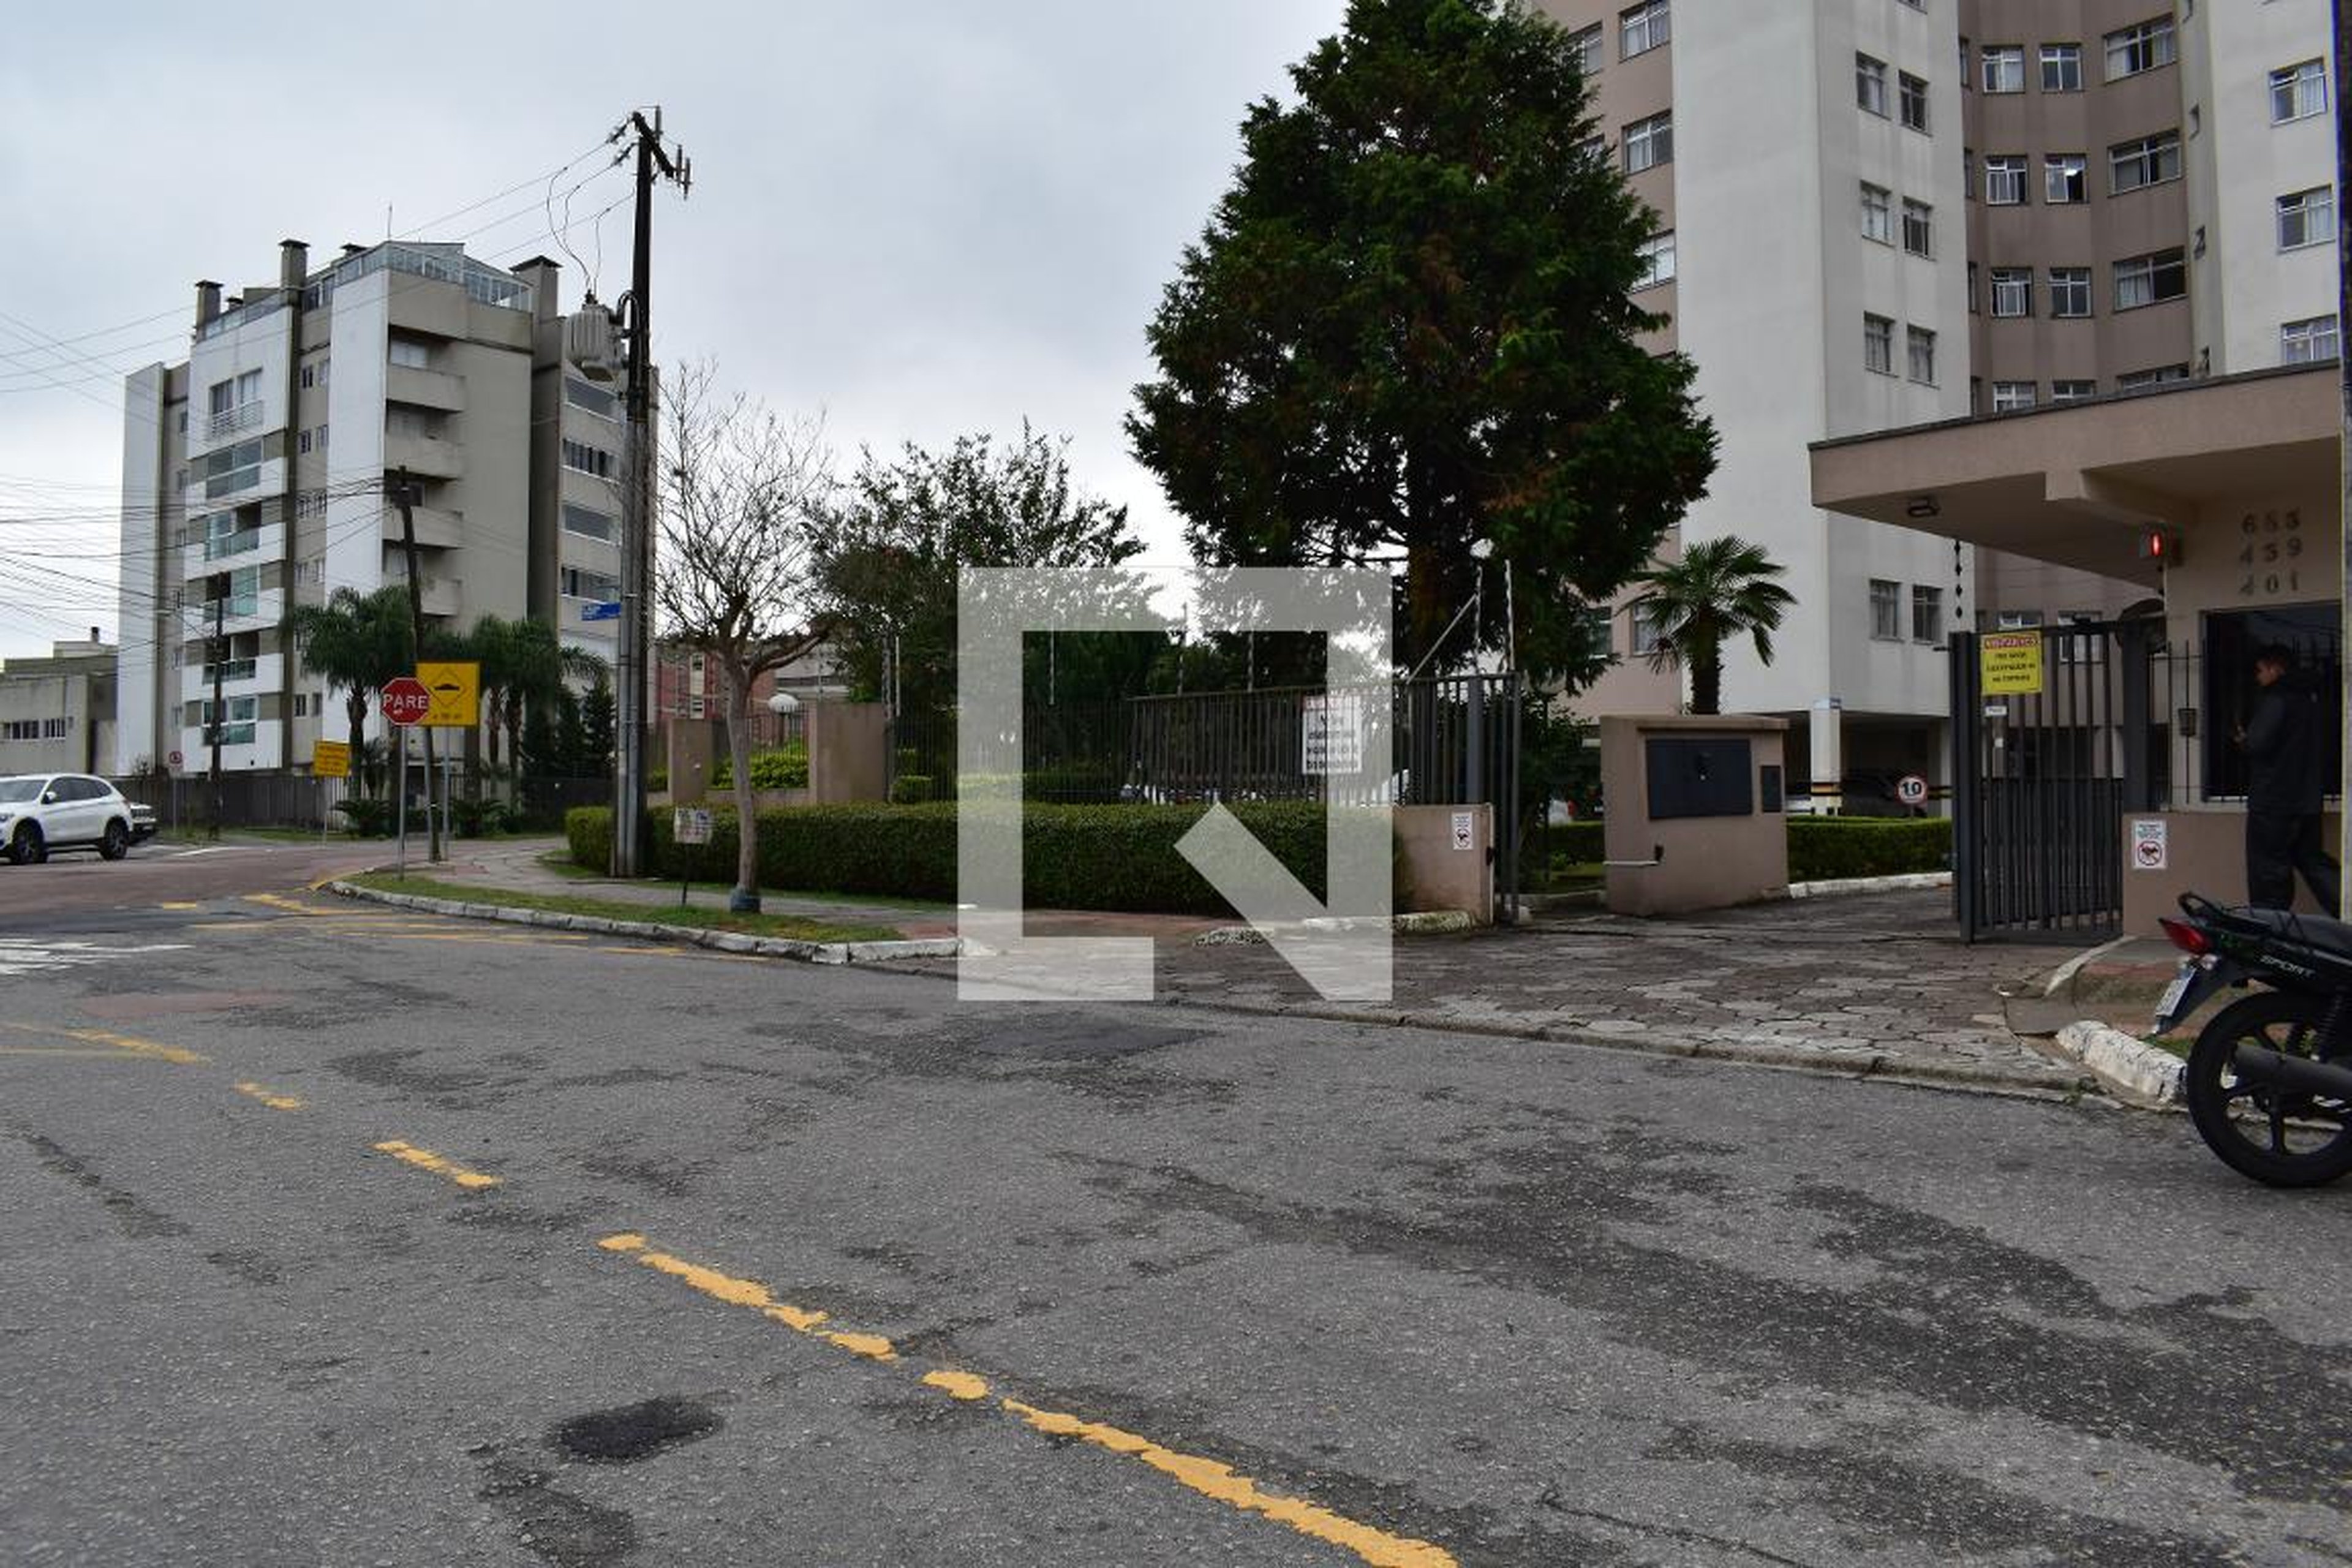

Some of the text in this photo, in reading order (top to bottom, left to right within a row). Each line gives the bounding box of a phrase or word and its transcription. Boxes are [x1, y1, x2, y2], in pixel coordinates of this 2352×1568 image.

[382, 694, 428, 709] PARE
[1902, 781, 1922, 796] 10
[2260, 955, 2316, 978] SPORT
